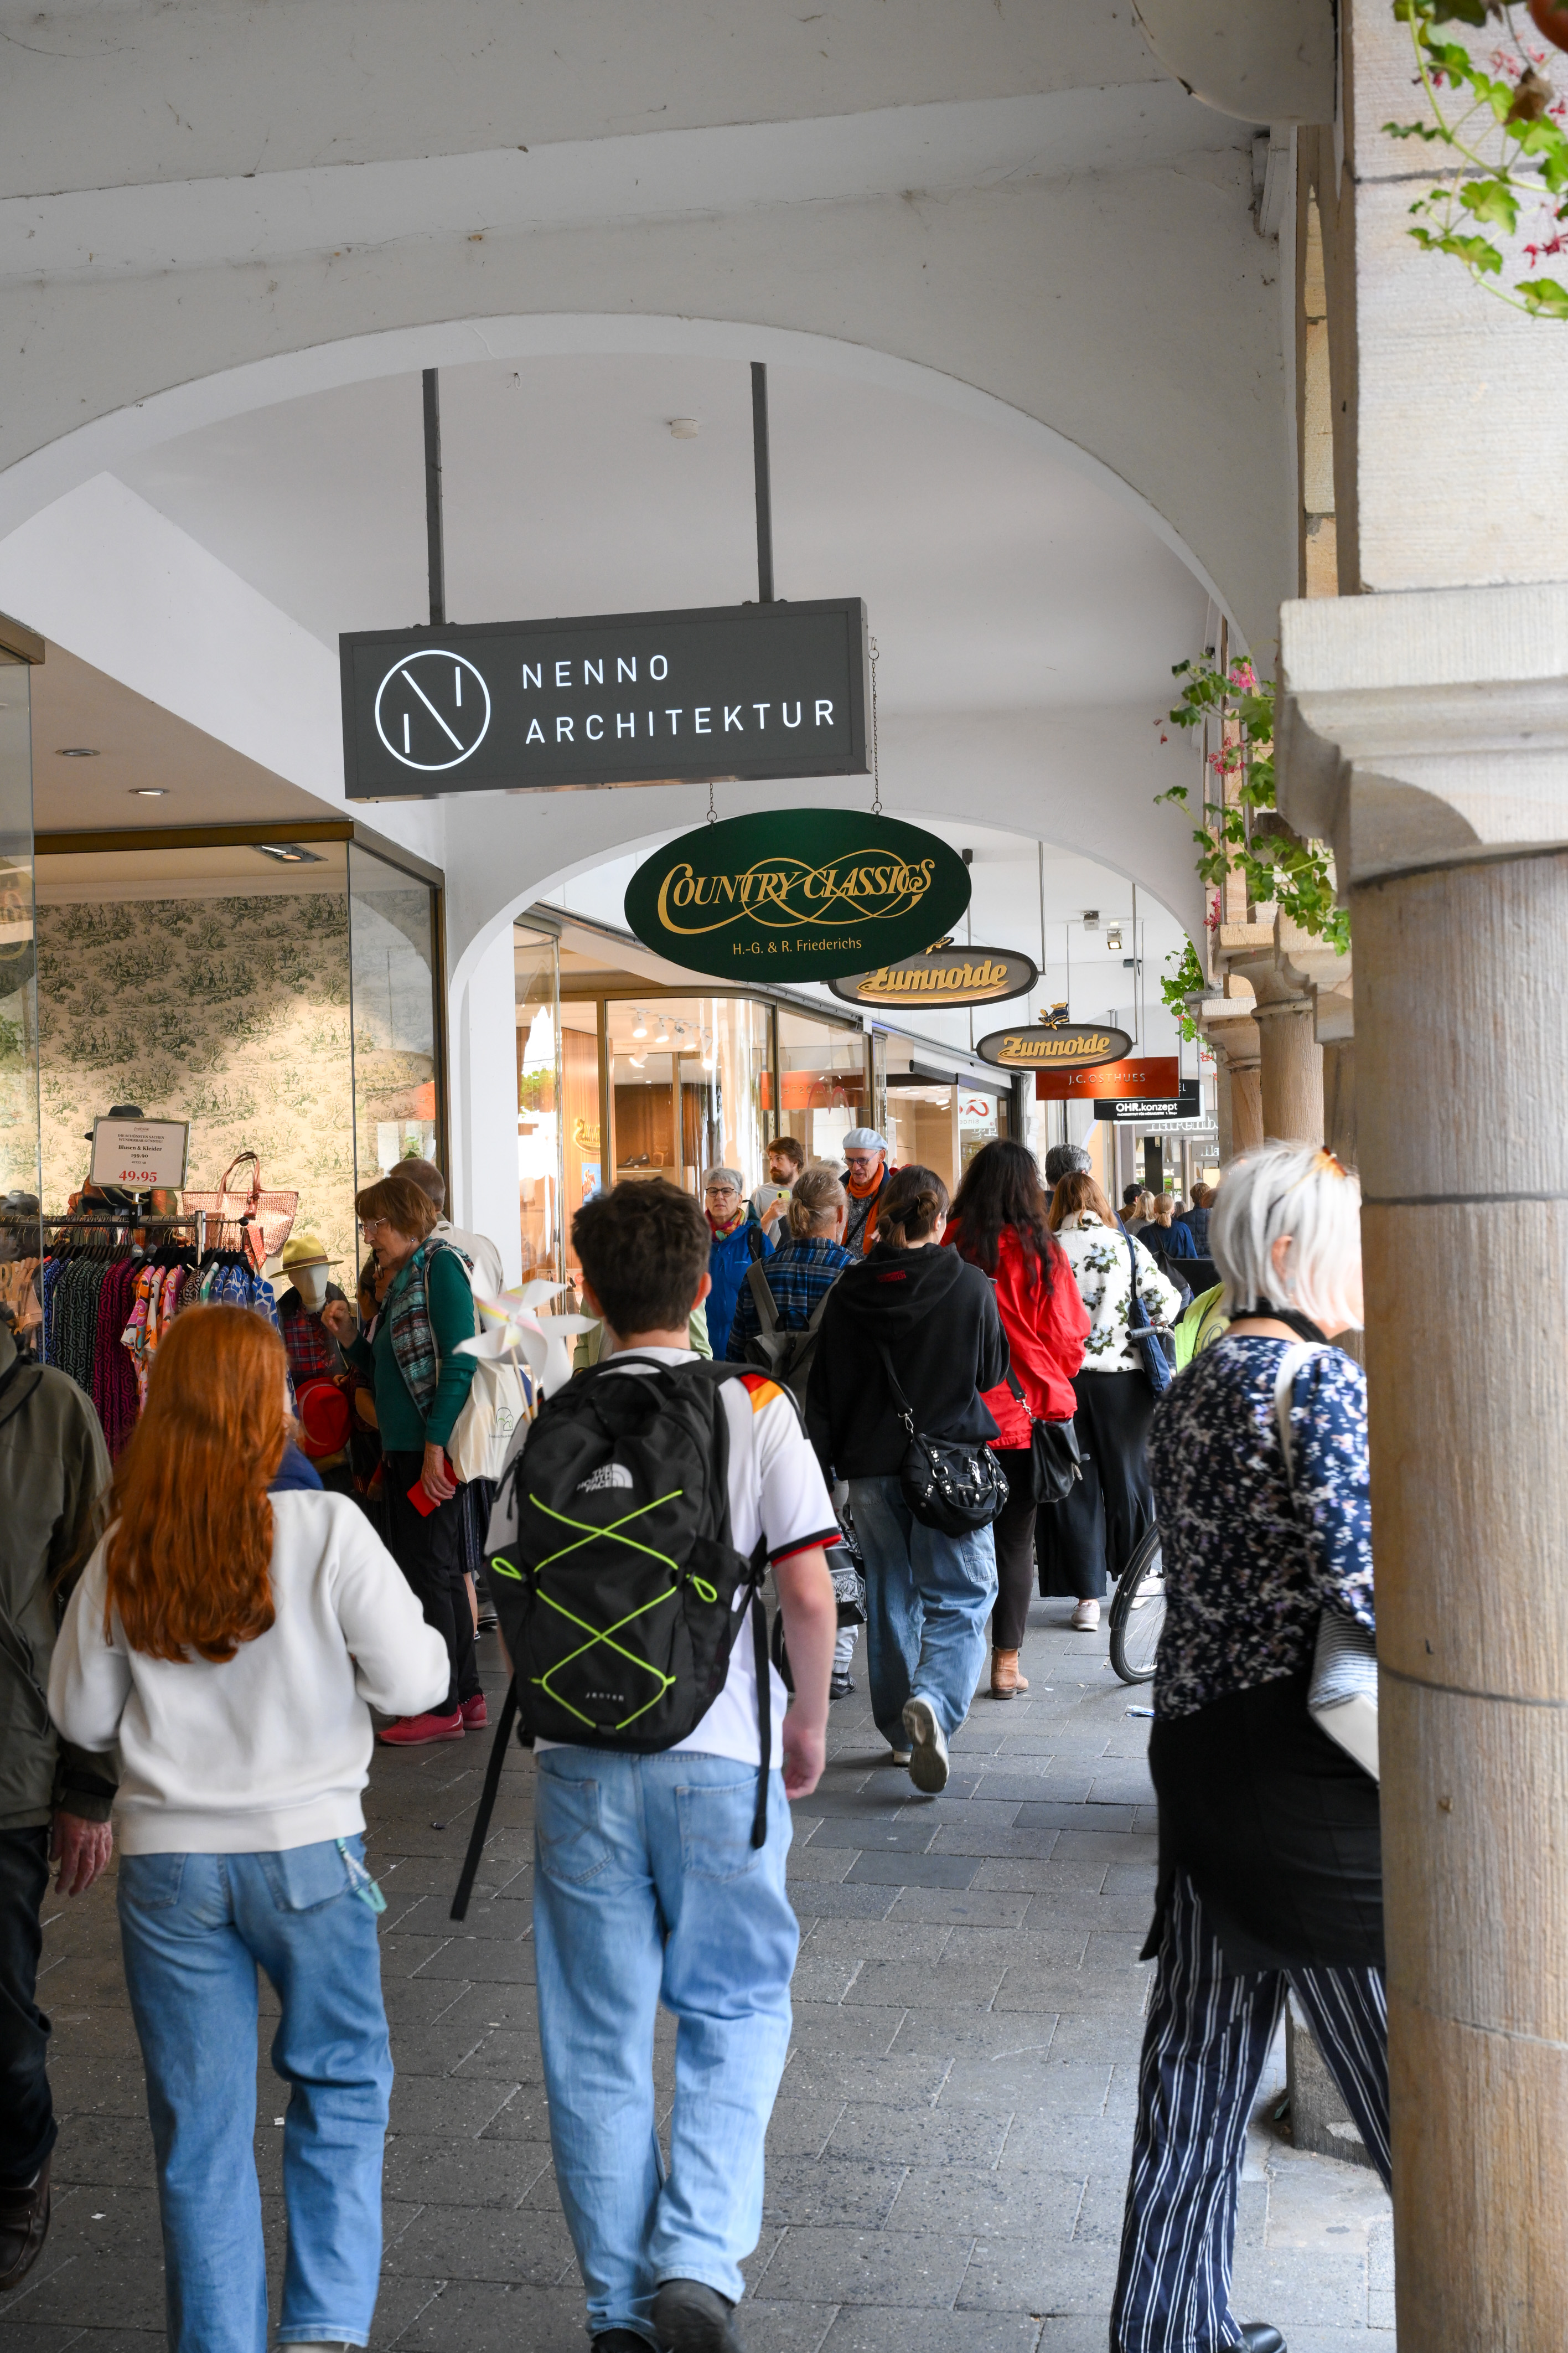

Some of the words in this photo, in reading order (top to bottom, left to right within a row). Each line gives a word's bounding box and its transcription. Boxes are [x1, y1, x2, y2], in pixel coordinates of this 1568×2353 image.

[522, 654, 668, 689] NENNO
[525, 700, 834, 744] ARCHITEKTUR
[658, 863, 803, 933] COUNTRY
[803, 858, 935, 900] CLASSICS
[733, 942, 763, 954] H.-G.
[768, 942, 778, 953] &
[782, 941, 793, 952] R.
[796, 937, 862, 951] Friederichs
[998, 1034, 1110, 1057] Zumnorde
[1069, 1075, 1086, 1086] J.C.
[1089, 1073, 1146, 1083] OSTHUES
[1116, 1102, 1178, 1113] OHR.konzept
[118, 1170, 157, 1183] 49,95
